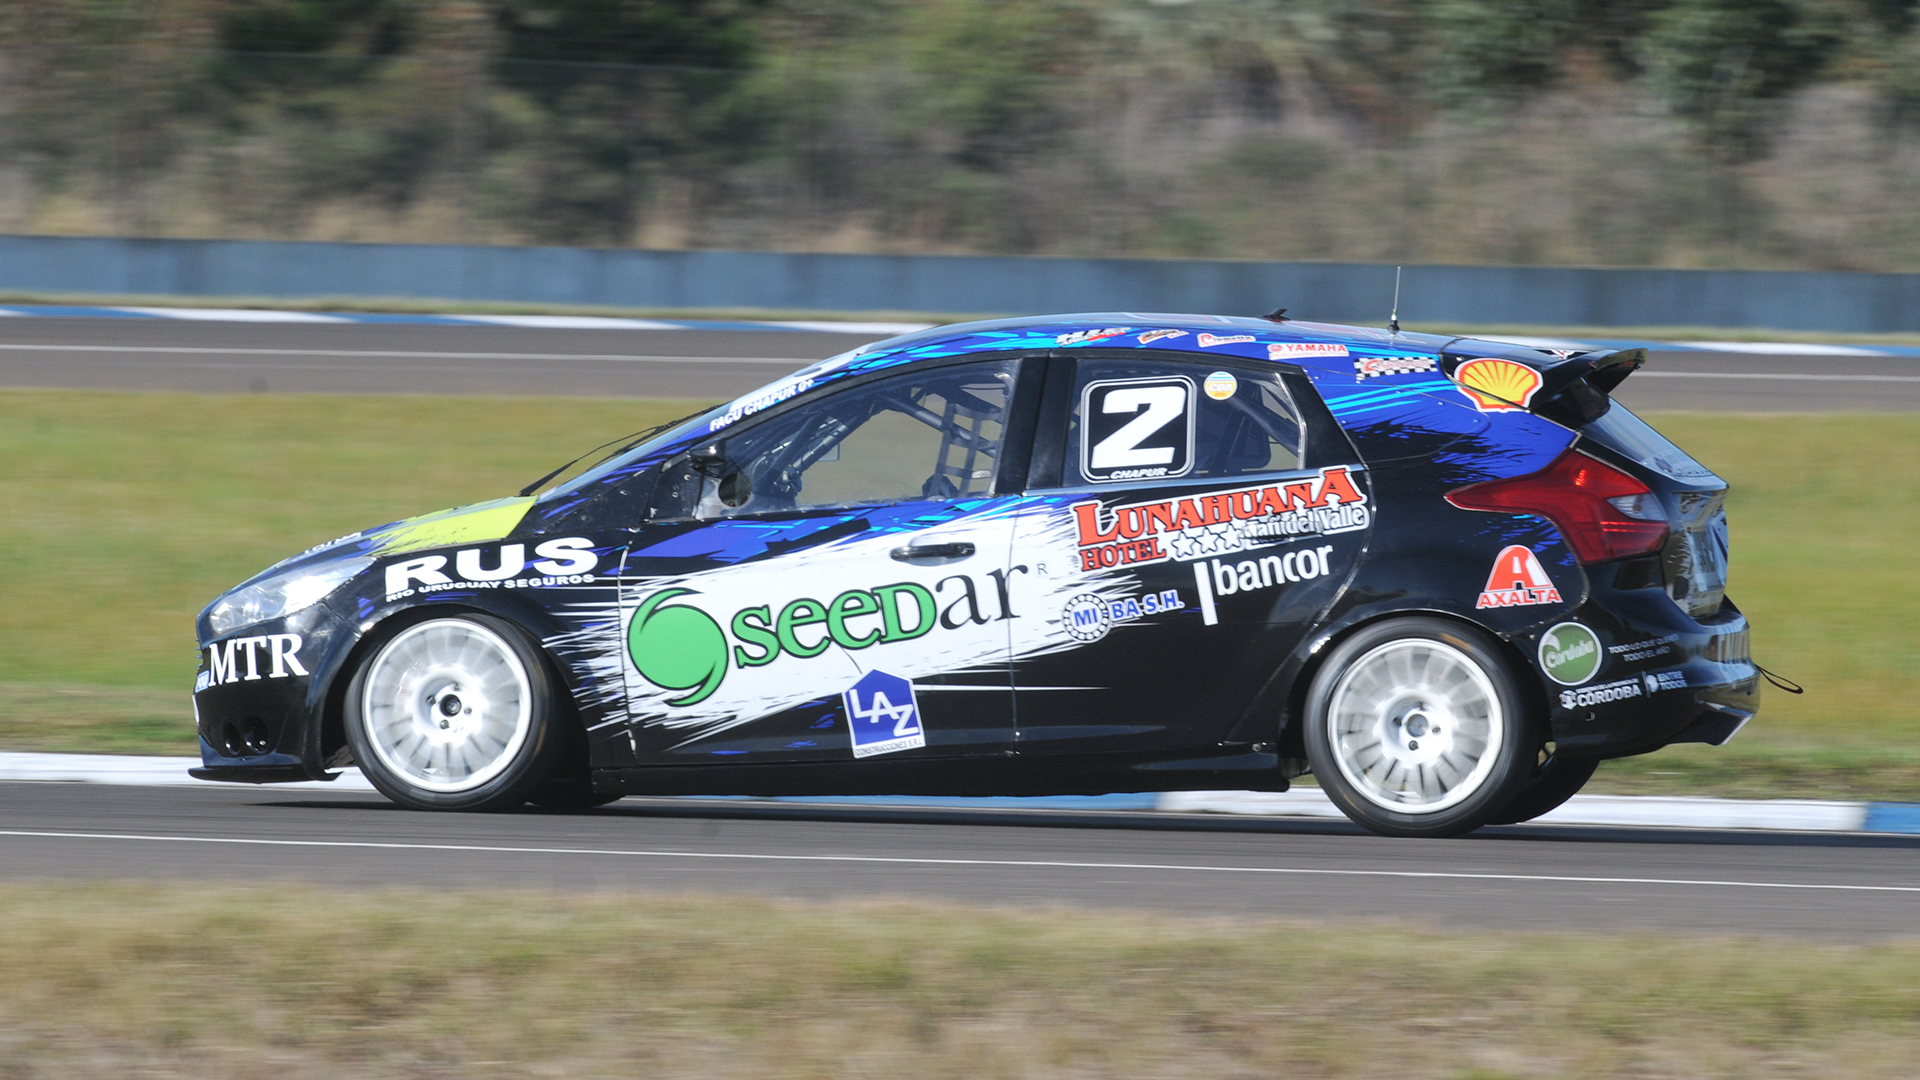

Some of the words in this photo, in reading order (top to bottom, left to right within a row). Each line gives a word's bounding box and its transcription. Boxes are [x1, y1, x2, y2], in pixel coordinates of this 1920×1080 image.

[1286, 344, 1346, 352] YAMAHA
[709, 408, 743, 432] FACU
[744, 384, 797, 416] CHAPUR
[1090, 386, 1186, 469] 2
[1110, 467, 1168, 480] CHAPUR
[1073, 468, 1363, 547] LUNAHUANA
[1317, 504, 1365, 530] Valle
[385, 537, 599, 596] RUS
[1079, 537, 1167, 571] HOTEL
[1211, 545, 1334, 596] bancor
[386, 588, 415, 602] RIO
[418, 581, 501, 593] URUGUAY
[504, 574, 596, 589] SEGUROS
[1479, 589, 1561, 608] AXALTA
[1073, 606, 1099, 627] MI
[208, 633, 310, 687] MTR
[849, 688, 920, 737] LAZ
